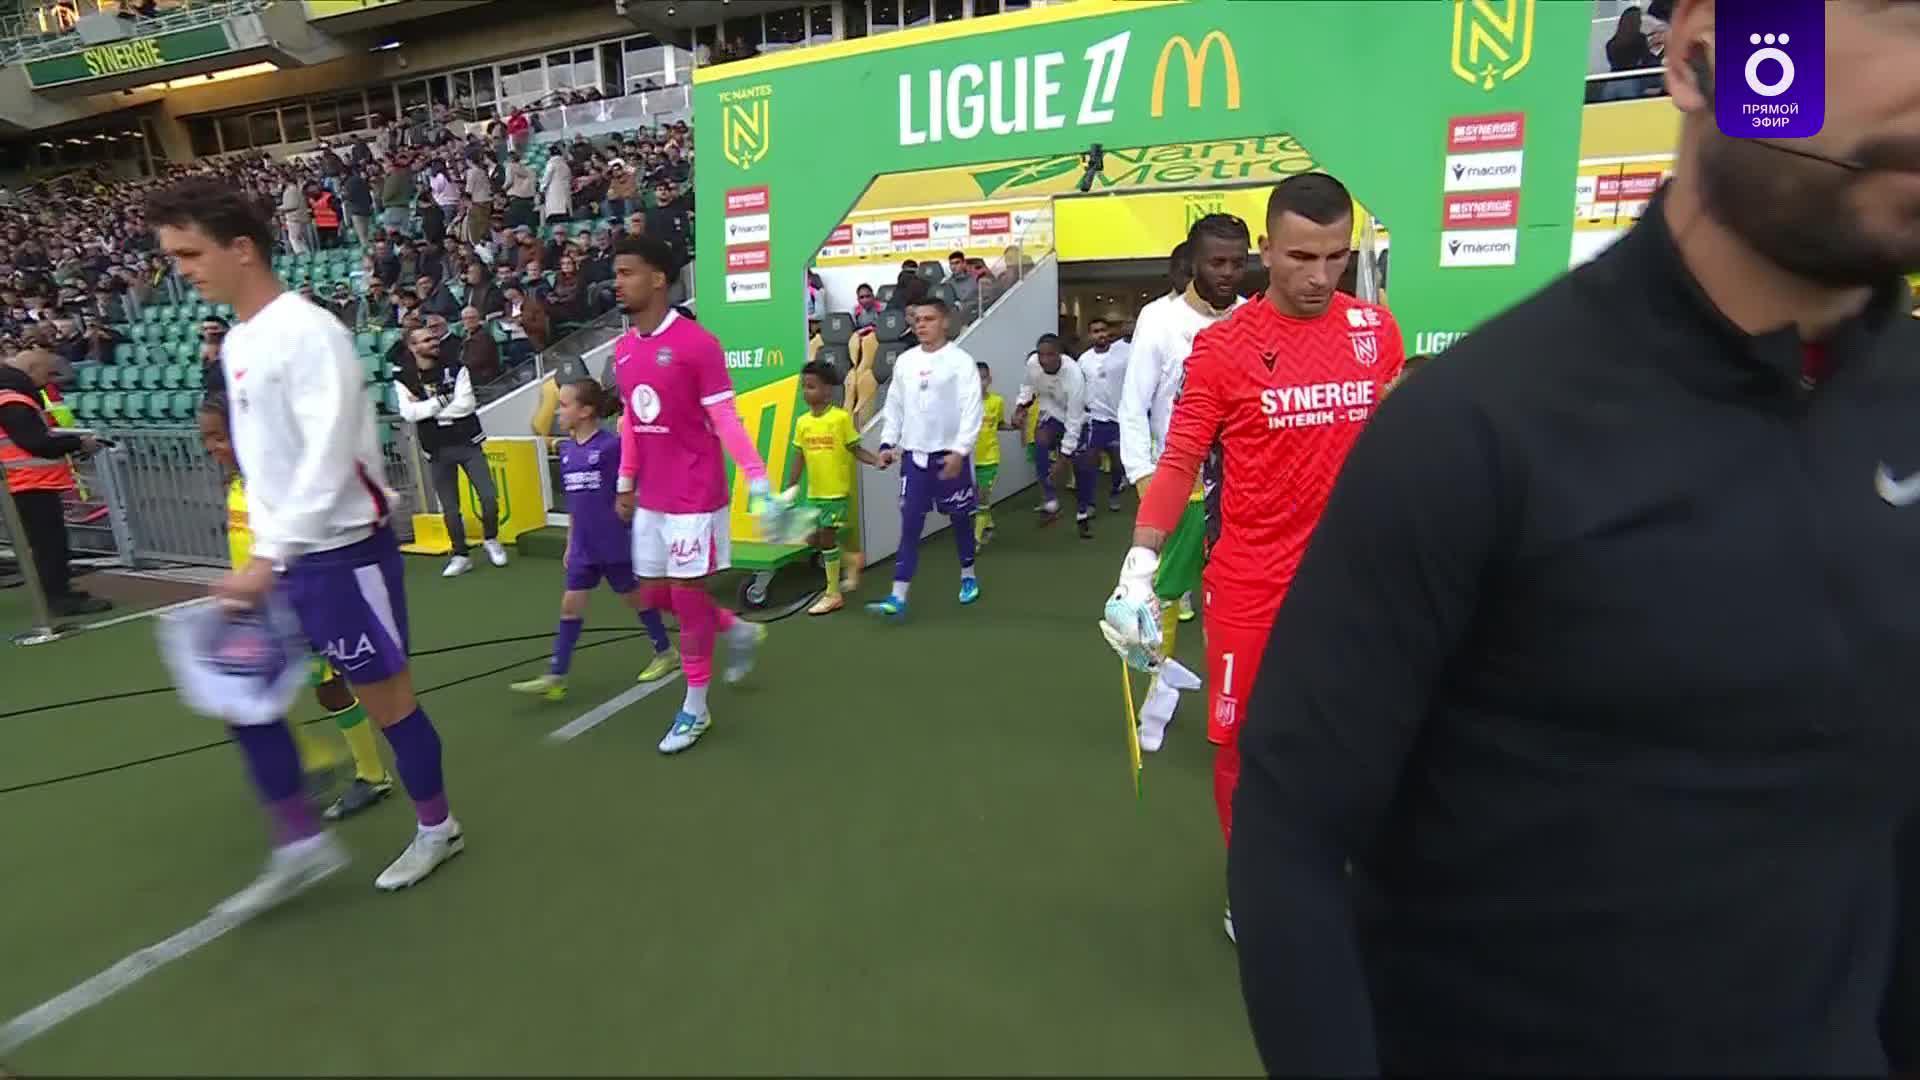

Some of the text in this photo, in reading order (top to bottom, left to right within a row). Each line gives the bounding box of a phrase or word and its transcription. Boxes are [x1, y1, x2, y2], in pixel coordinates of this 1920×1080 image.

[84, 39, 165, 76] SYNERGIE
[900, 51, 1065, 146] LIGUE
[1464, 121, 1518, 136] SYNERGIE
[1467, 165, 1517, 177] macron
[1460, 200, 1512, 214] SYNERGIE
[1463, 242, 1511, 254] macron
[724, 350, 753, 368] IGUE
[1261, 381, 1375, 414] SYNERGIE
[1268, 411, 1335, 430] INTERIM
[1222, 652, 1235, 696] 1
